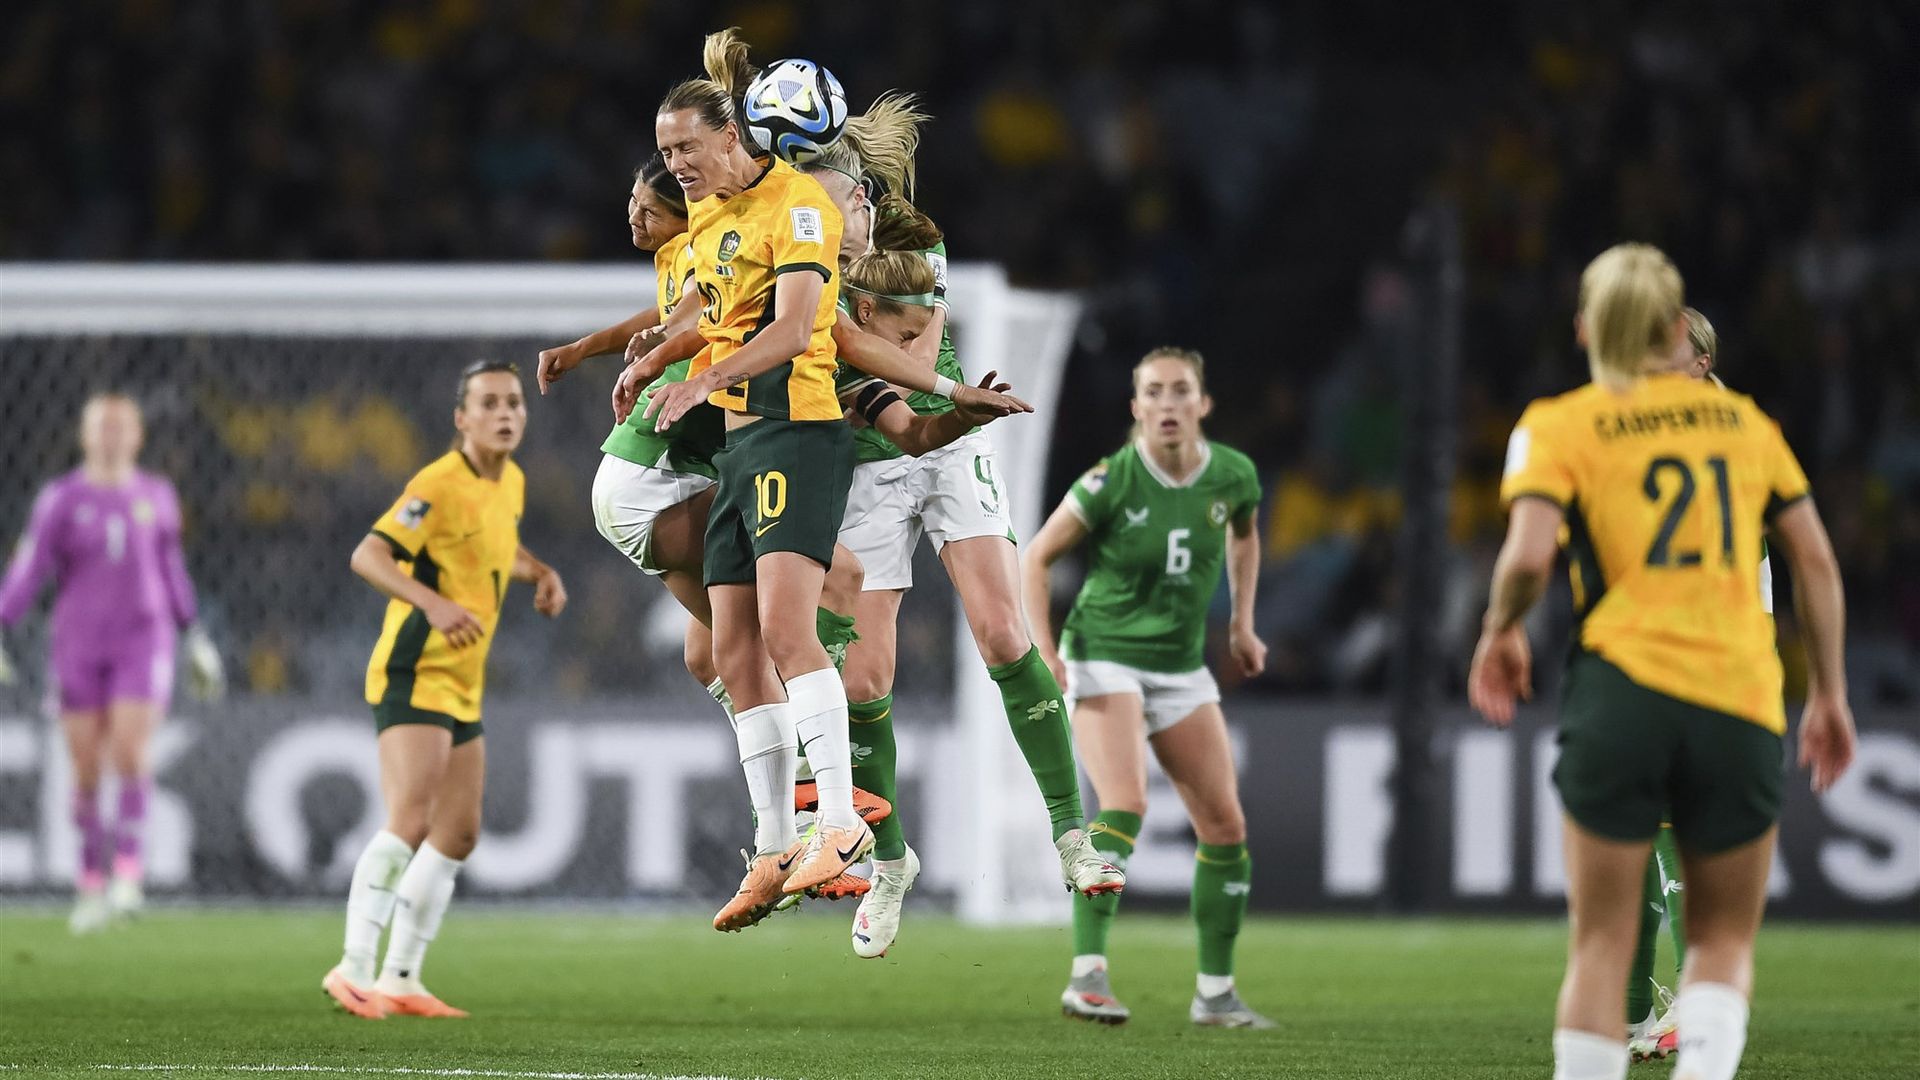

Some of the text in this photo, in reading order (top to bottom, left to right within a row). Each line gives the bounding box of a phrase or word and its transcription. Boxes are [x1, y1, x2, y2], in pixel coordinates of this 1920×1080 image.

[1594, 402, 1743, 439] CARPENTER
[754, 470, 788, 524] 10
[1643, 456, 1735, 568] 21
[1165, 528, 1192, 575] 6
